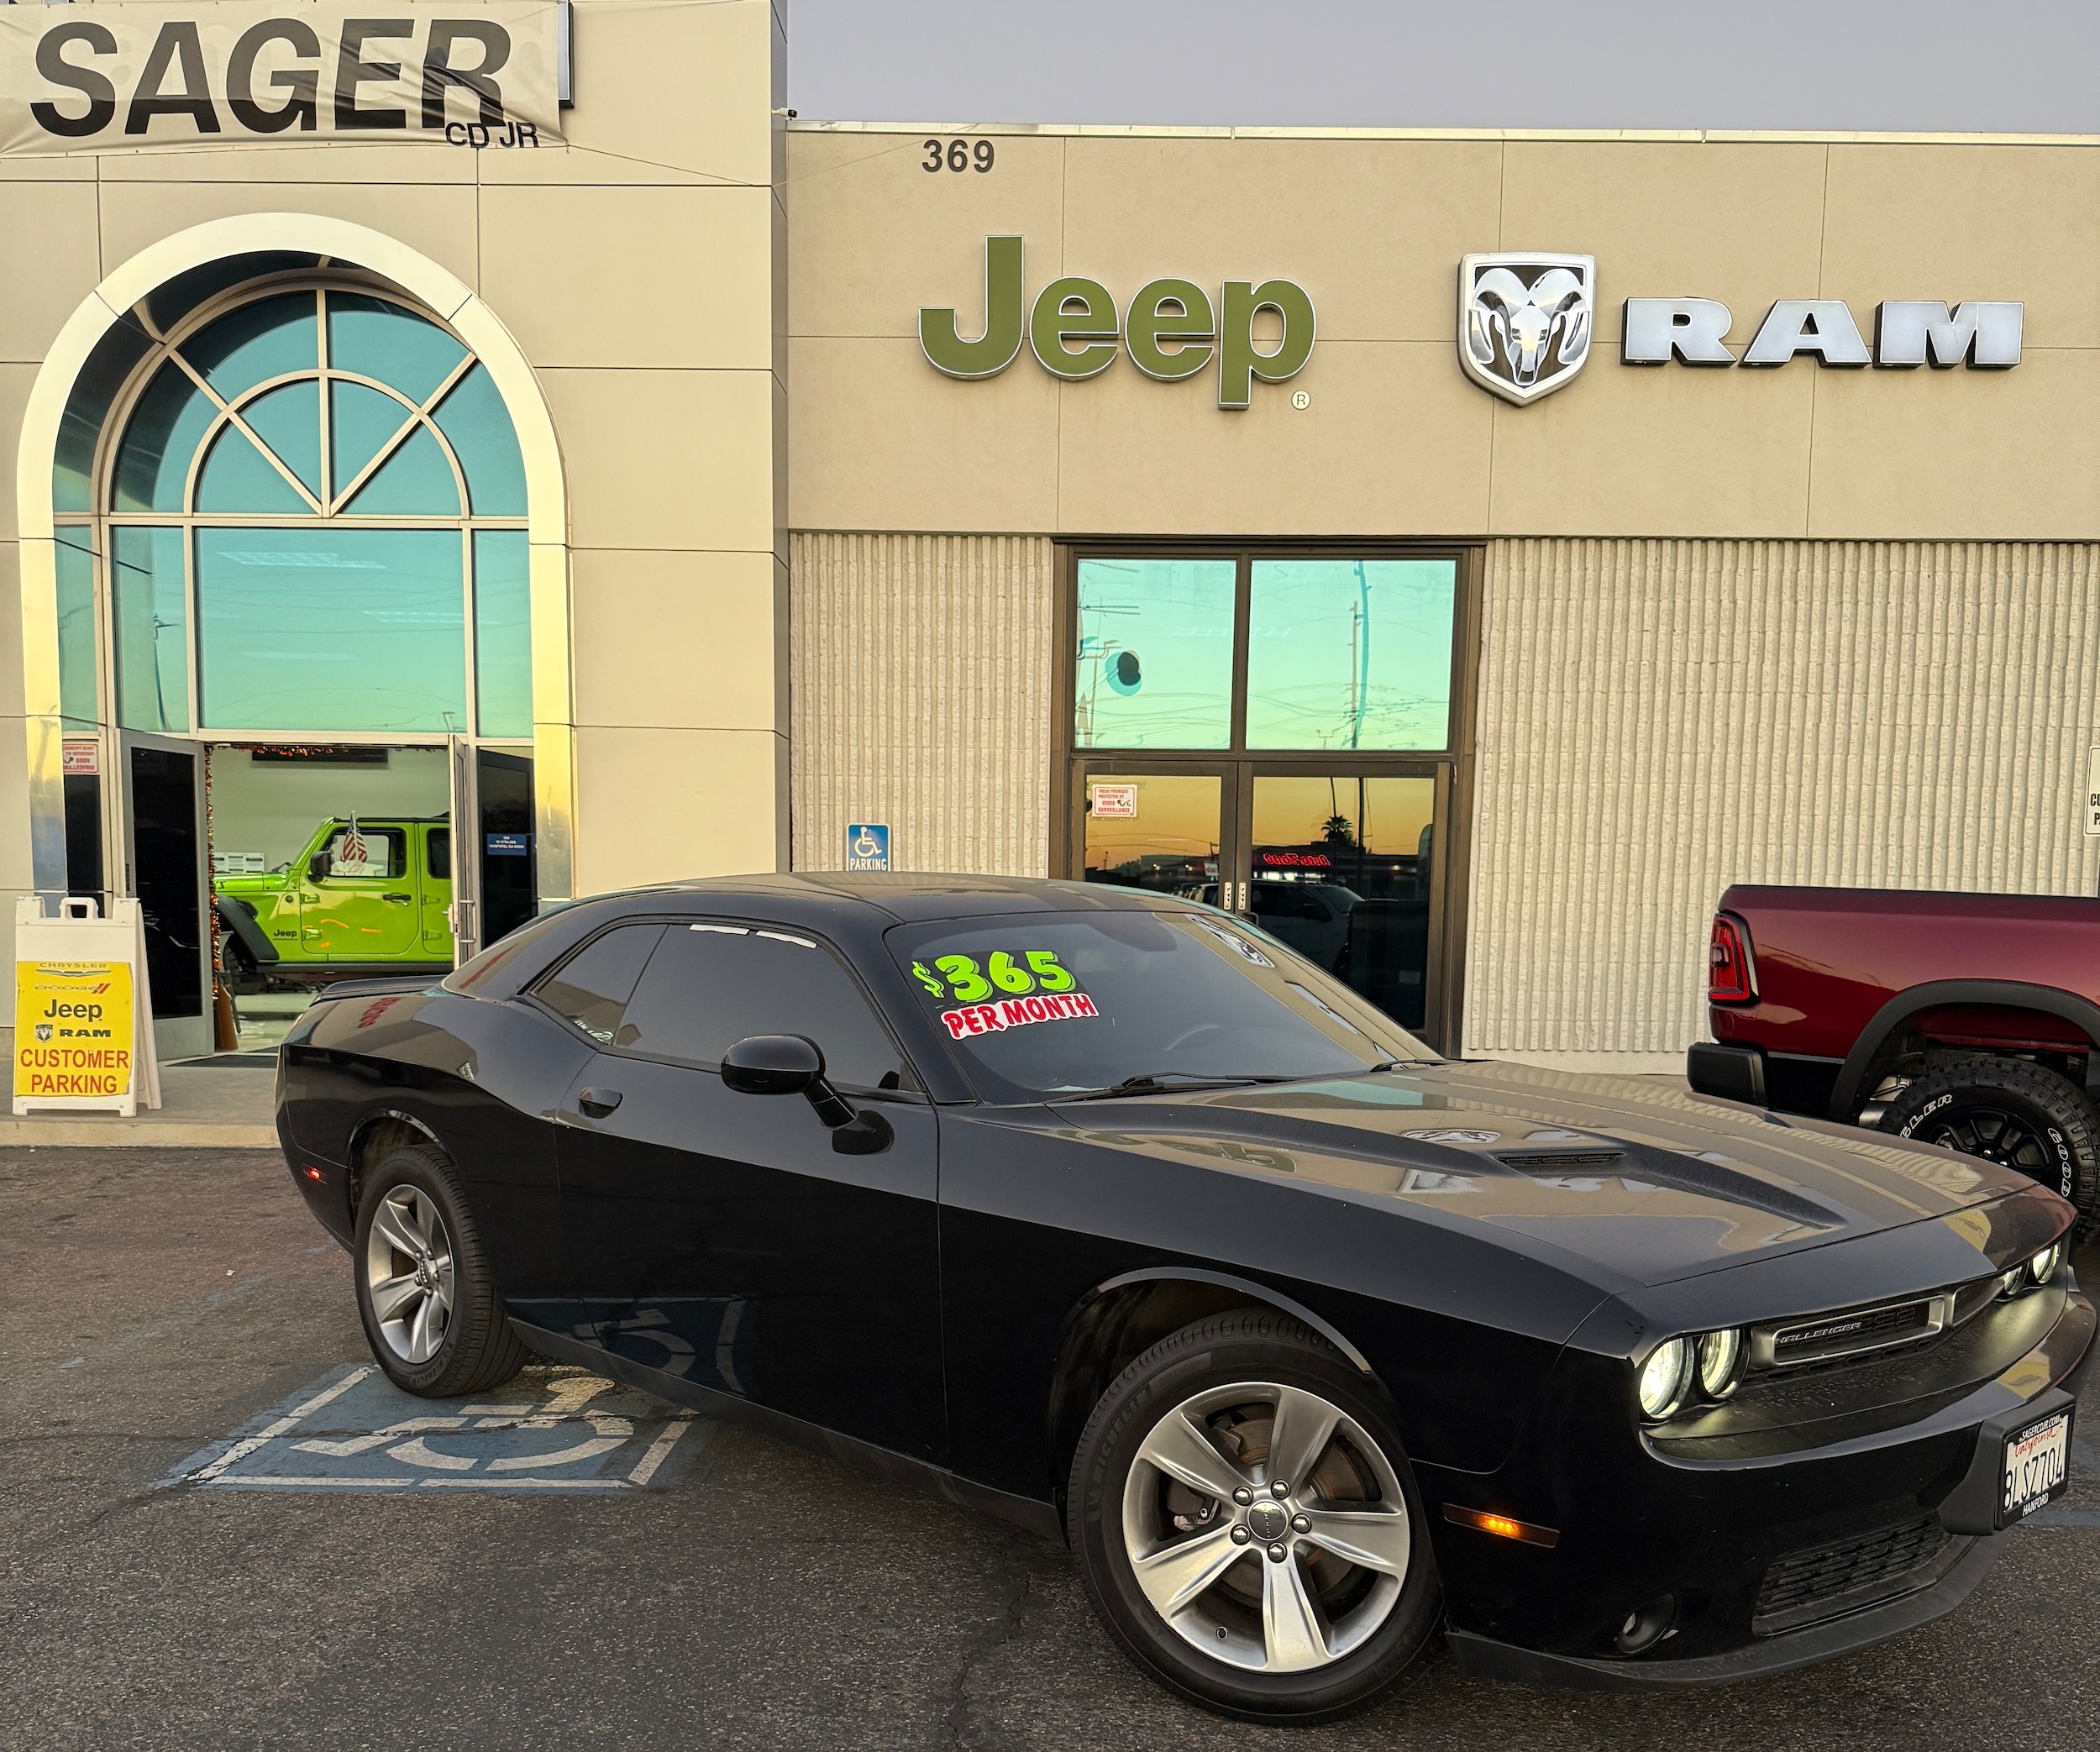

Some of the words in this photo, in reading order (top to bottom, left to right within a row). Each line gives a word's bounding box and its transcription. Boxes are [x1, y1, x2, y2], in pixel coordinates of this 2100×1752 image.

[30, 18, 511, 137] SAGER
[921, 139, 995, 173] 369
[917, 234, 1317, 411] Jeep
[1620, 296, 2025, 370] RAM
[850, 858, 887, 871] PARKING
[273, 929, 297, 938] Jeep
[911, 951, 1076, 1002] $365
[44, 999, 102, 1022] Jeep
[943, 1005, 1005, 1038] PER
[1003, 994, 1097, 1025] MONTH
[60, 1029, 111, 1038] RAM
[20, 1048, 129, 1069] CUSTOMER
[31, 1073, 118, 1094] PARKING
[1773, 1322, 1862, 1343] HALLENGER
[2022, 1492, 2050, 1518] HANFORD
